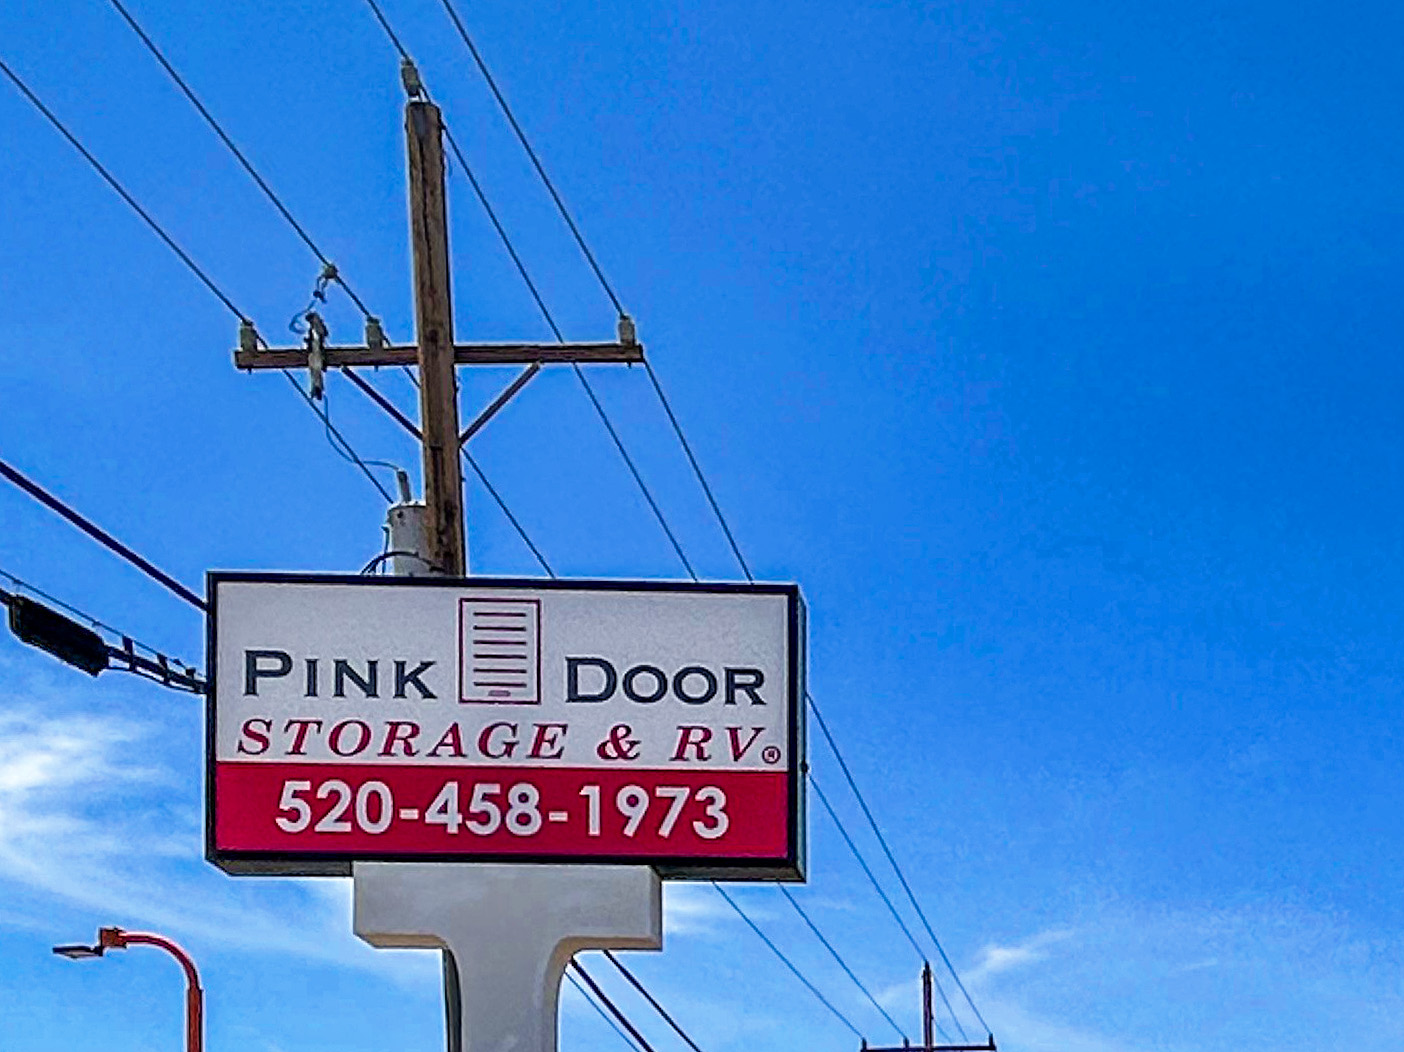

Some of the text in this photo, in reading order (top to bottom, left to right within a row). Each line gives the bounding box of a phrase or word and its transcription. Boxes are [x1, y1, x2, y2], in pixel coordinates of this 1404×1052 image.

[236, 718, 569, 760] STORAGE
[596, 724, 642, 760] &
[275, 779, 731, 840] 520-458-1973
